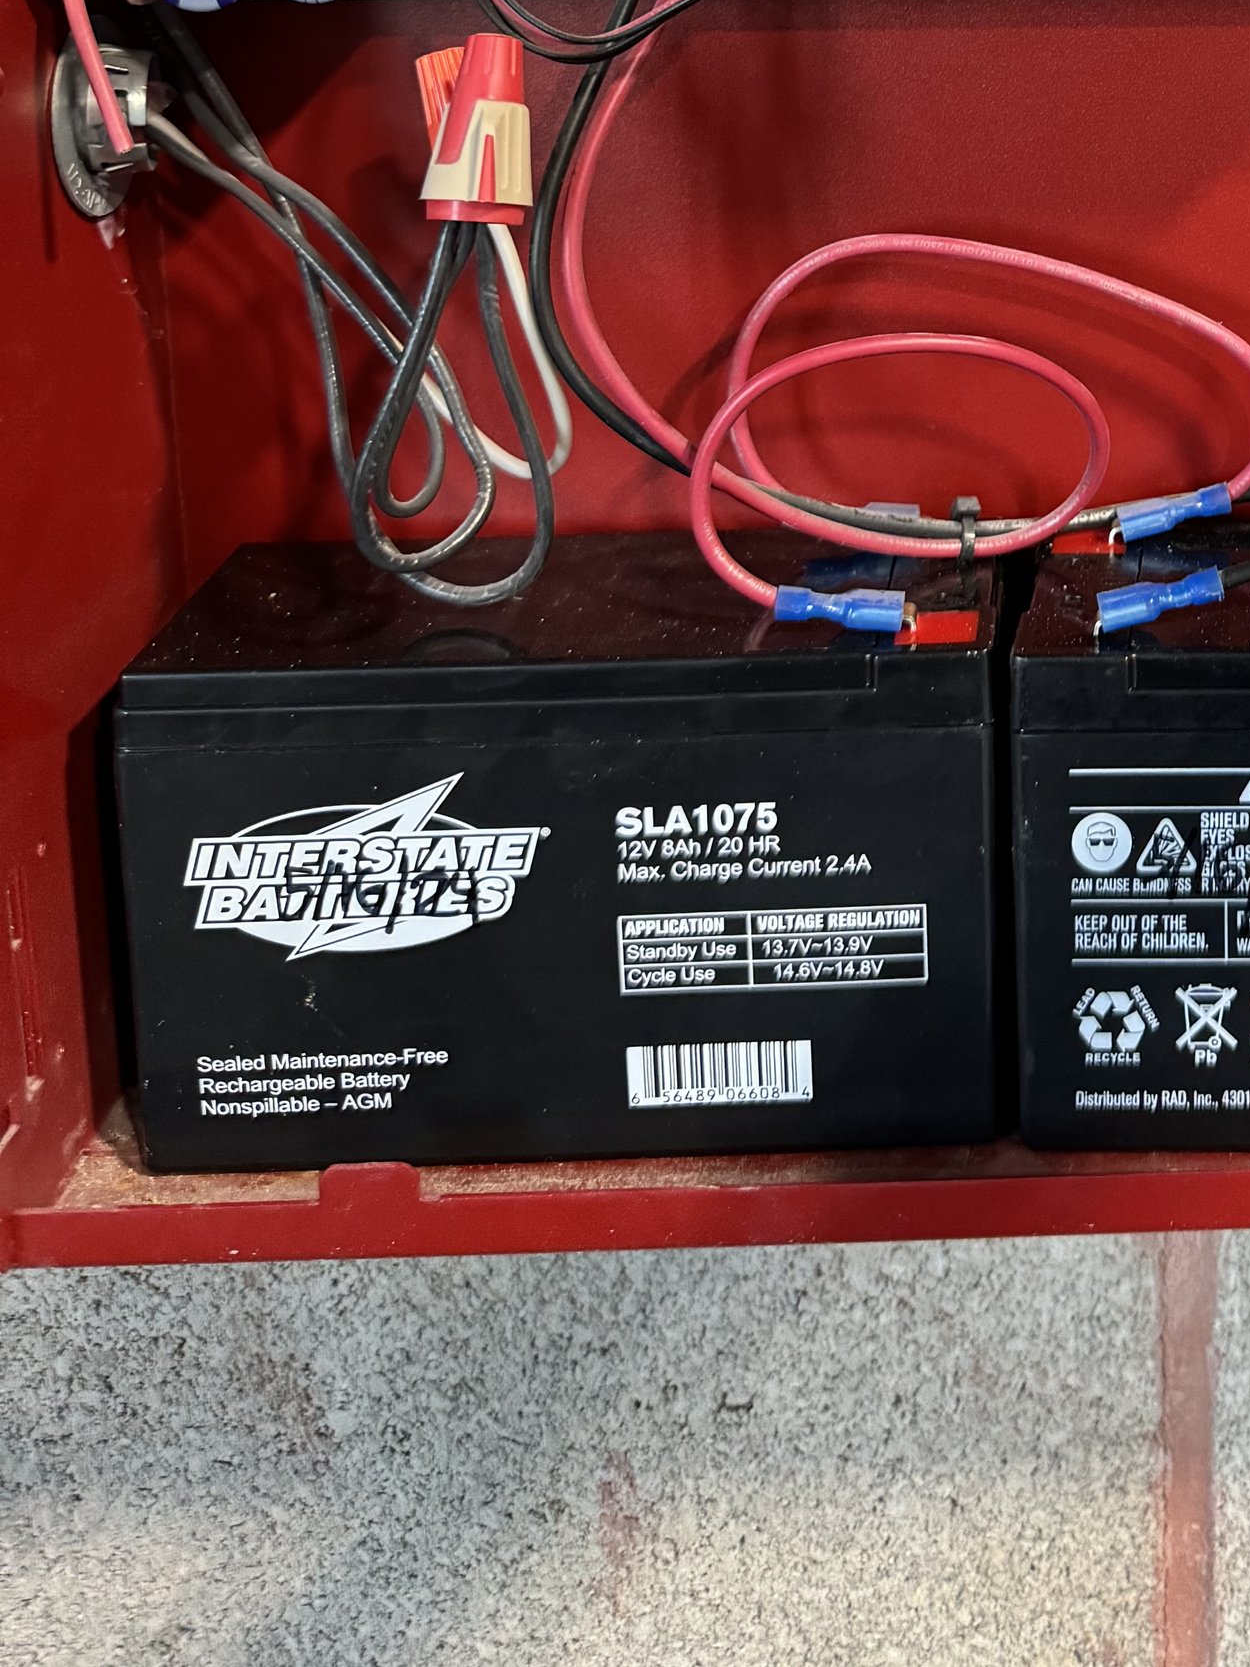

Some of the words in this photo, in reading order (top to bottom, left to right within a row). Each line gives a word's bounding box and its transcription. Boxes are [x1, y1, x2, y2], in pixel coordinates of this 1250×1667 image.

[614, 801, 779, 837] SLA1075
[1200, 812, 1250, 830] SHIELD
[194, 832, 535, 880] INTERSTATE
[617, 840, 658, 861] 12V
[660, 838, 702, 860] 8Ah
[718, 836, 744, 856] 20
[749, 834, 781, 855] HR
[616, 862, 667, 883] Max.
[670, 858, 744, 884] Charge
[747, 856, 823, 877] Current
[824, 853, 872, 875] 2.4A
[624, 916, 726, 938] APPLICATION
[756, 912, 824, 932] VOLTAGE
[827, 909, 921, 929] REGULATION
[1074, 914, 1107, 932] KEEP
[1111, 914, 1138, 932] OUT
[1141, 914, 1159, 932] OF
[1162, 914, 1187, 932] THE
[626, 941, 697, 962] Standby
[701, 941, 737, 958] Use
[760, 934, 874, 958] 13.7V~13.9V
[1074, 932, 1117, 951] REACH
[1121, 932, 1138, 951] OF
[1141, 932, 1209, 951] CHILDREN.
[626, 966, 677, 987] Cycle
[680, 965, 716, 983] Use
[772, 959, 885, 982] 14.6V~14.8V
[196, 1054, 266, 1073] Sealed
[271, 1047, 449, 1071] Maintenance-Free
[198, 1073, 336, 1096] Rechargeable
[340, 1071, 411, 1092] Battery
[662, 1089, 716, 1103] 56489
[726, 1087, 781, 1100] 06608
[200, 1095, 321, 1118] Nonspillable
[341, 1092, 393, 1110] AGM
